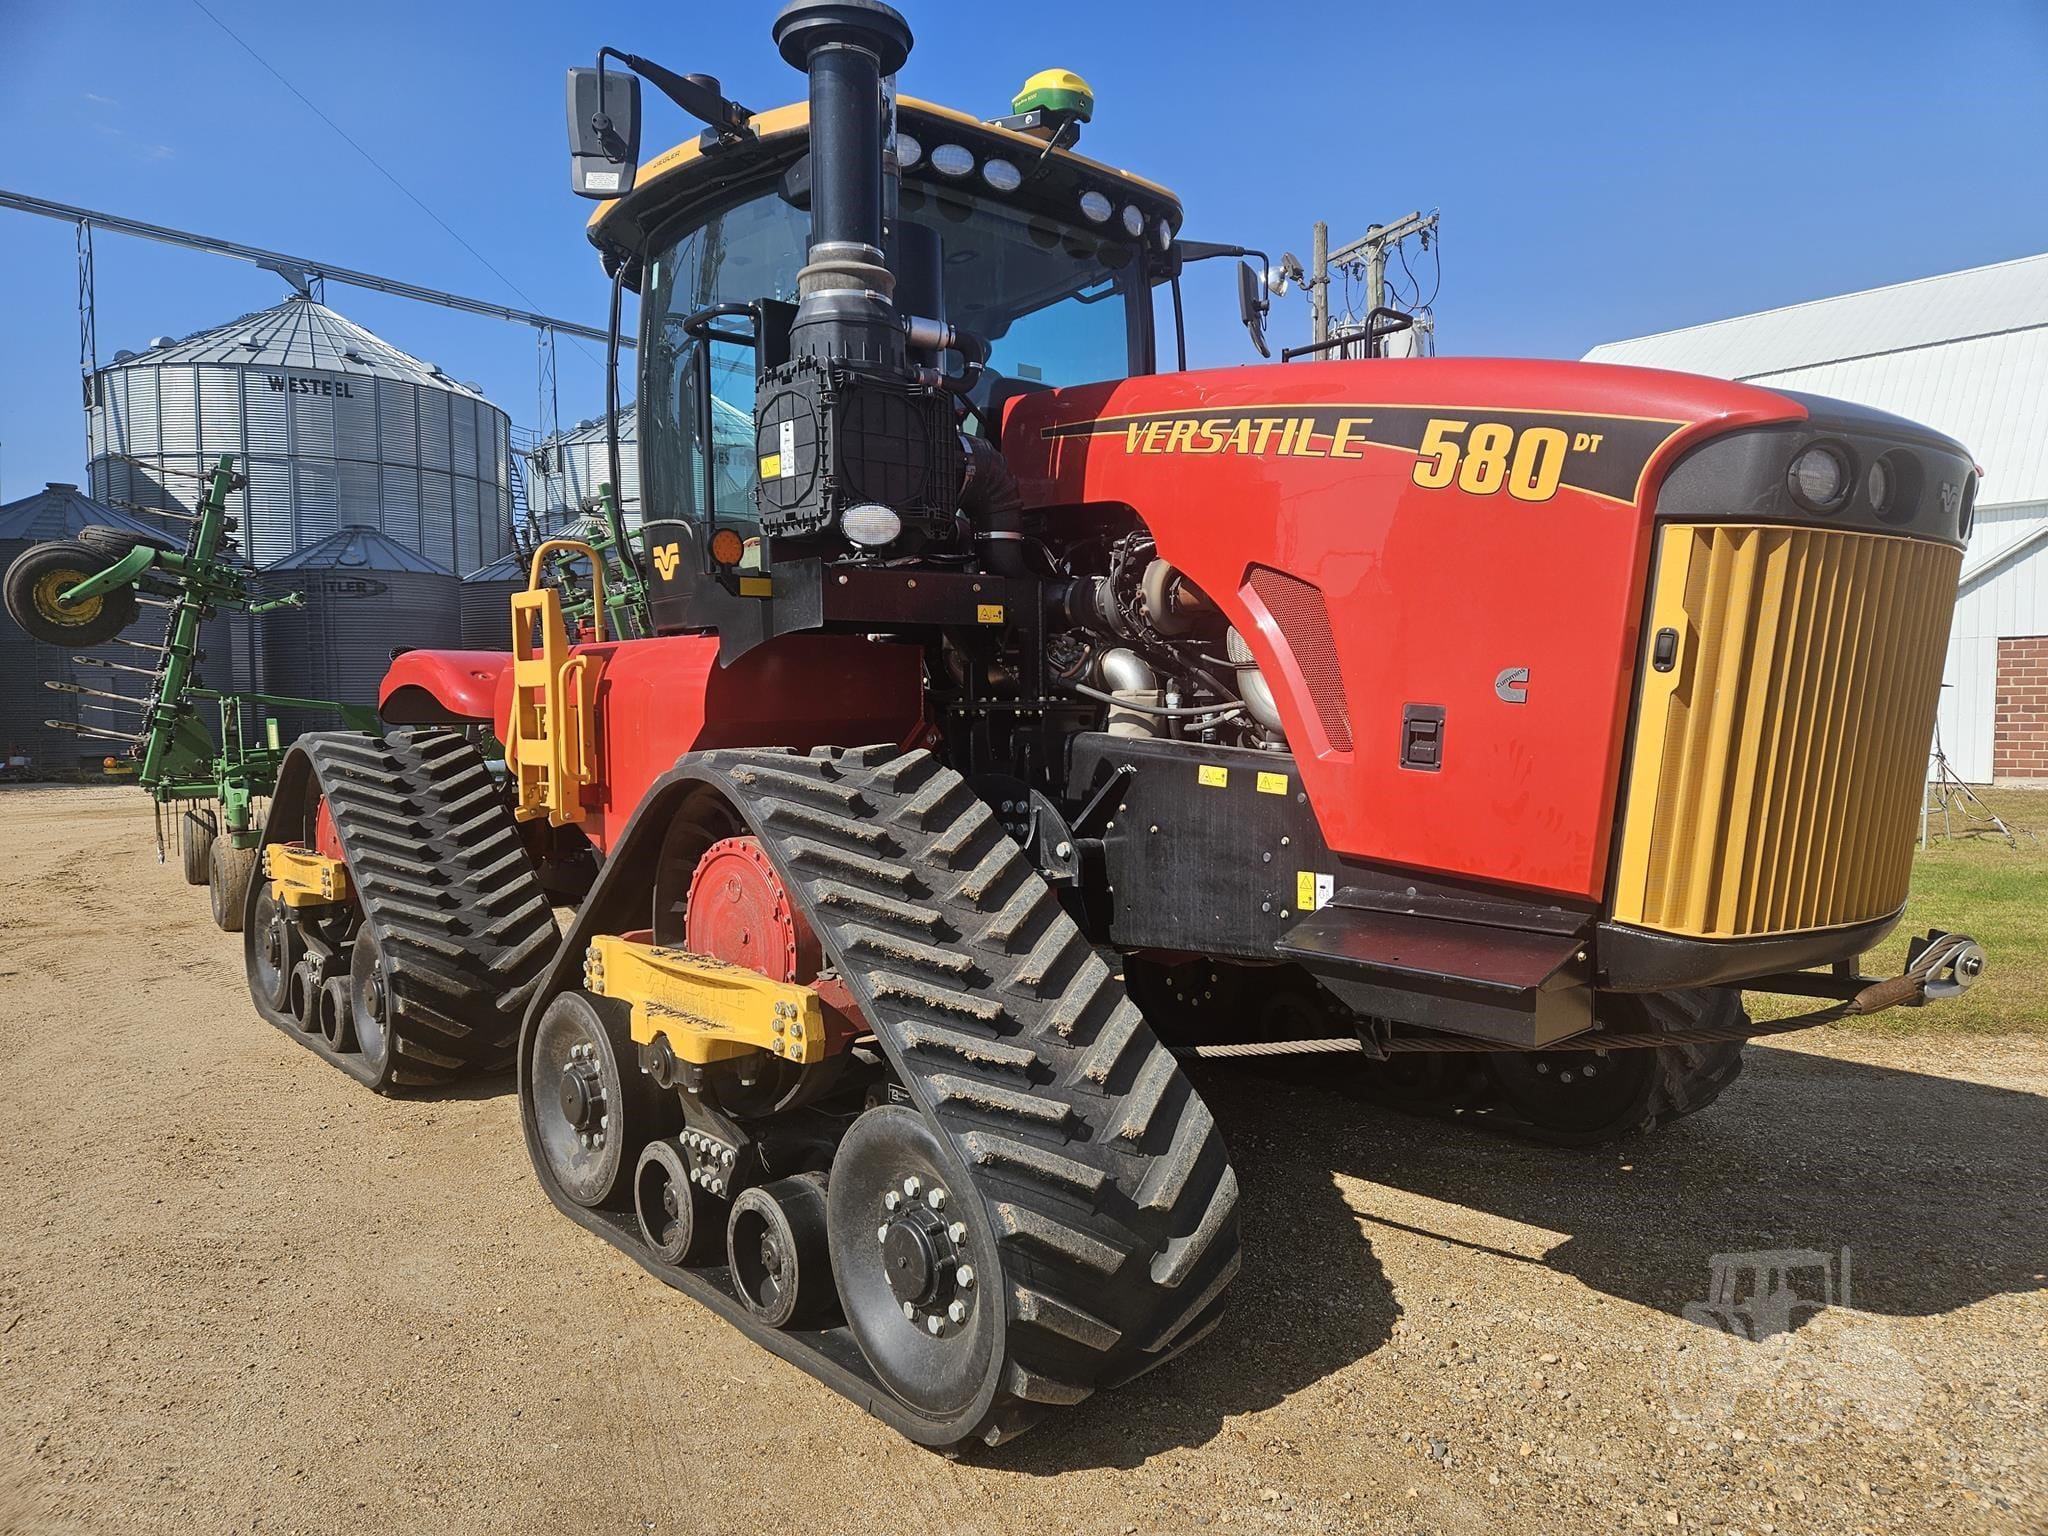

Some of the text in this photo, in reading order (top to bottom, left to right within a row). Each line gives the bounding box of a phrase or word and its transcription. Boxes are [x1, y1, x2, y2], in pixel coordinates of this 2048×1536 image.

[267, 375, 354, 398] WESTEEL
[1125, 417, 1374, 459] VERSATILE
[1411, 418, 1604, 502] 580 DT
